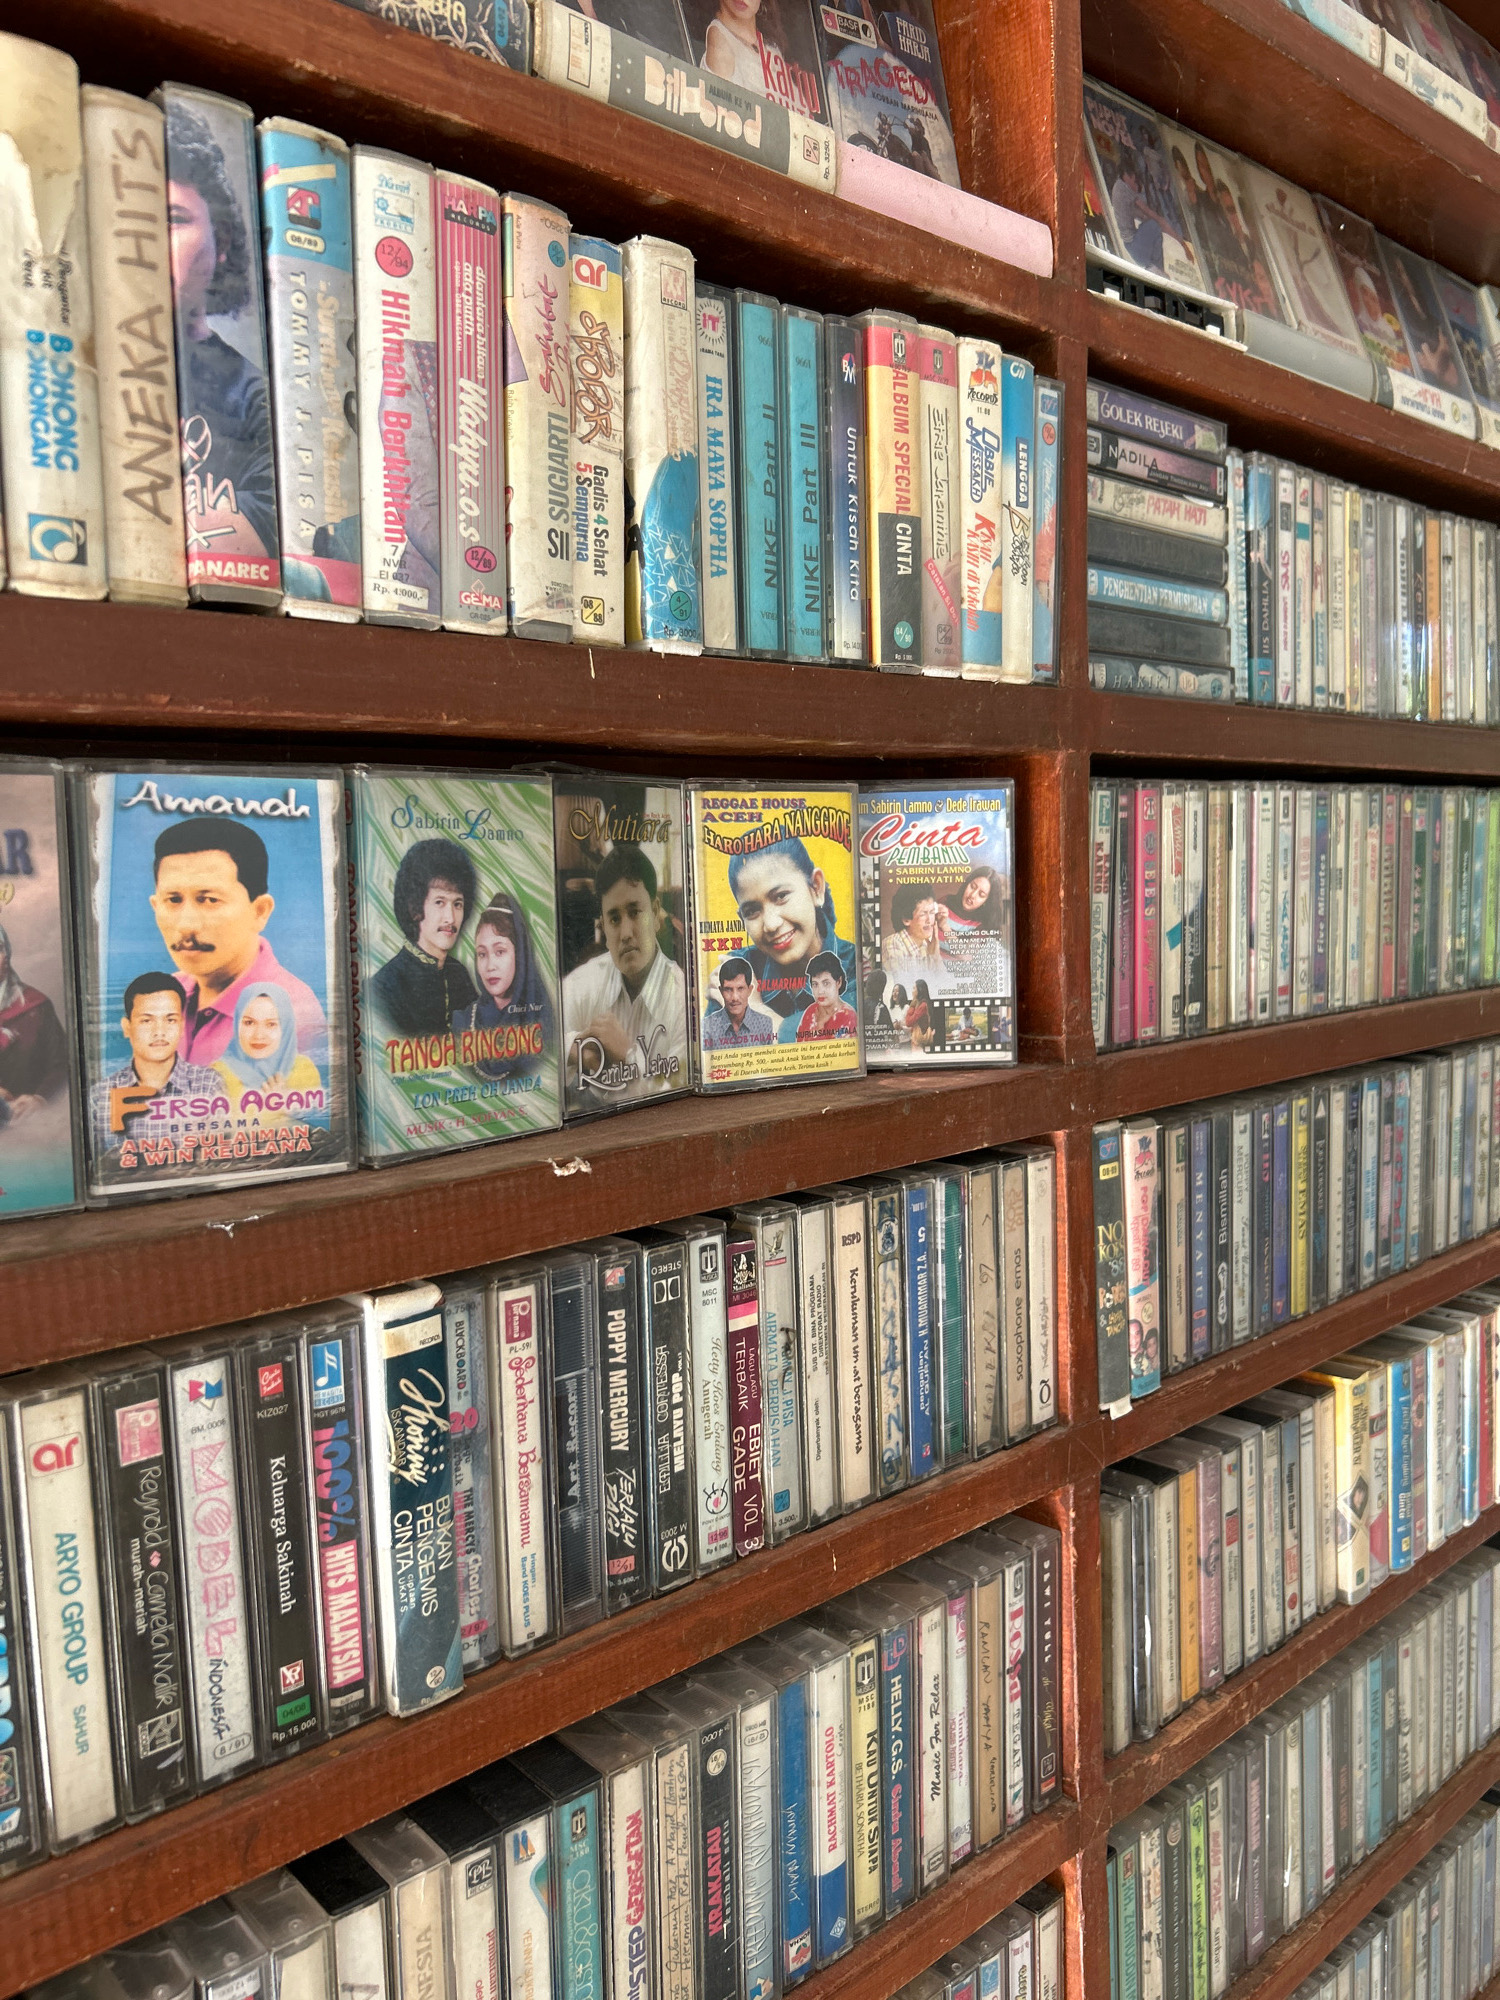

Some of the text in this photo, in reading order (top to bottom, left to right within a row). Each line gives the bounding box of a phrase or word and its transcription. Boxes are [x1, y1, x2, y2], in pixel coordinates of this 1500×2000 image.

[450, 212, 491, 232] RECORDS
[381, 289, 411, 399] Hikmah
[118, 303, 173, 525] ANEKA
[892, 368, 913, 515] ALBUM SPECIAL
[1100, 402, 1143, 429] GOLEK
[705, 374, 728, 579] IRA MAYA SOPHA
[763, 438, 779, 498] Part
[1108, 443, 1158, 470] NADILA
[575, 461, 593, 564] 5 Sempurna
[592, 464, 610, 513] Gadis
[800, 422, 820, 614] NIKE Part III
[845, 426, 860, 601] Untuk Kisah Kita
[383, 558, 407, 570] NVR
[592, 529, 610, 577] Sehat
[764, 516, 779, 589] NIKE
[895, 523, 913, 576] CINTA
[460, 591, 501, 610] GEMA
[1102, 575, 1158, 603] PENGHENTIAN
[1261, 580, 1270, 638] DAHLIA
[122, 779, 311, 819] Amanah
[390, 794, 525, 842] Sabirin Lamno
[567, 800, 673, 845] Mutiara
[701, 797, 807, 810] REGGAE HOUSE
[702, 811, 763, 823] ACEH
[869, 800, 901, 815] Sabirin
[902, 798, 932, 814] Lamno
[945, 798, 968, 813] Dede
[968, 797, 1001, 813] Irawan
[702, 805, 852, 857] HARO HARA NANGGROE
[859, 813, 986, 858] Cinta
[884, 845, 971, 867] PEMBANTU
[895, 865, 972, 876] SABIRIN LAMNO
[895, 875, 954, 885] NURHAYATI
[1316, 853, 1327, 955] Five Minutes
[702, 936, 744, 952] KKN
[385, 1022, 544, 1075] TANOH RINCONG
[575, 1023, 679, 1091] Ramlan Yahya
[724, 1052, 739, 1060] Anda
[778, 1047, 800, 1055] cassette
[240, 1089, 325, 1116] AGAM
[413, 1075, 543, 1111] LON PREH OH JANDA
[121, 1124, 310, 1155] ANA SULAIMAN
[145, 1146, 194, 1167] WIN
[202, 1137, 313, 1162] KEULANA
[170, 1117, 261, 1134] BERSAMA
[1194, 1171, 1204, 1299] MENYATU
[1218, 1167, 1228, 1245] Bismillah
[816, 1283, 825, 1358] DIREKTORAT RADIO
[1013, 1248, 1024, 1382] saxophone emas
[606, 1308, 630, 1454] POPPY MERCURY
[734, 1336, 749, 1412] TERBAIK
[765, 1310, 781, 1468] AIRMATA PERPISAHAN
[256, 1403, 290, 1419] KIZ027
[671, 1372, 686, 1473] MELAYU POP
[701, 1378, 714, 1441] Anugerah
[508, 1355, 538, 1548] Sederhana Bersamamu
[748, 1422, 761, 1482] EBIET
[269, 1455, 297, 1615] Keluarga Sakinah
[434, 1493, 453, 1570] BUKAN
[615, 1466, 639, 1550] TERLALU
[313, 1419, 364, 1686] 100% HITS MALAYSIA
[394, 1509, 415, 1574] CINTA
[416, 1502, 439, 1616] PENGEMIS
[520, 1556, 531, 1629] Band KOES PLUS
[54, 1531, 90, 1757] ARYO GROUP SAHUR
[929, 1672, 943, 1802] Music For Relax
[824, 1725, 839, 1854] RACHMAT KARTOLO
[854, 1761, 865, 1858] BETHARIA SONATHA
[865, 1730, 880, 1875] KAU UNTUK SIAPA
[706, 1825, 723, 1938] KRAKATAU
[627, 1924, 647, 1985] STEP
